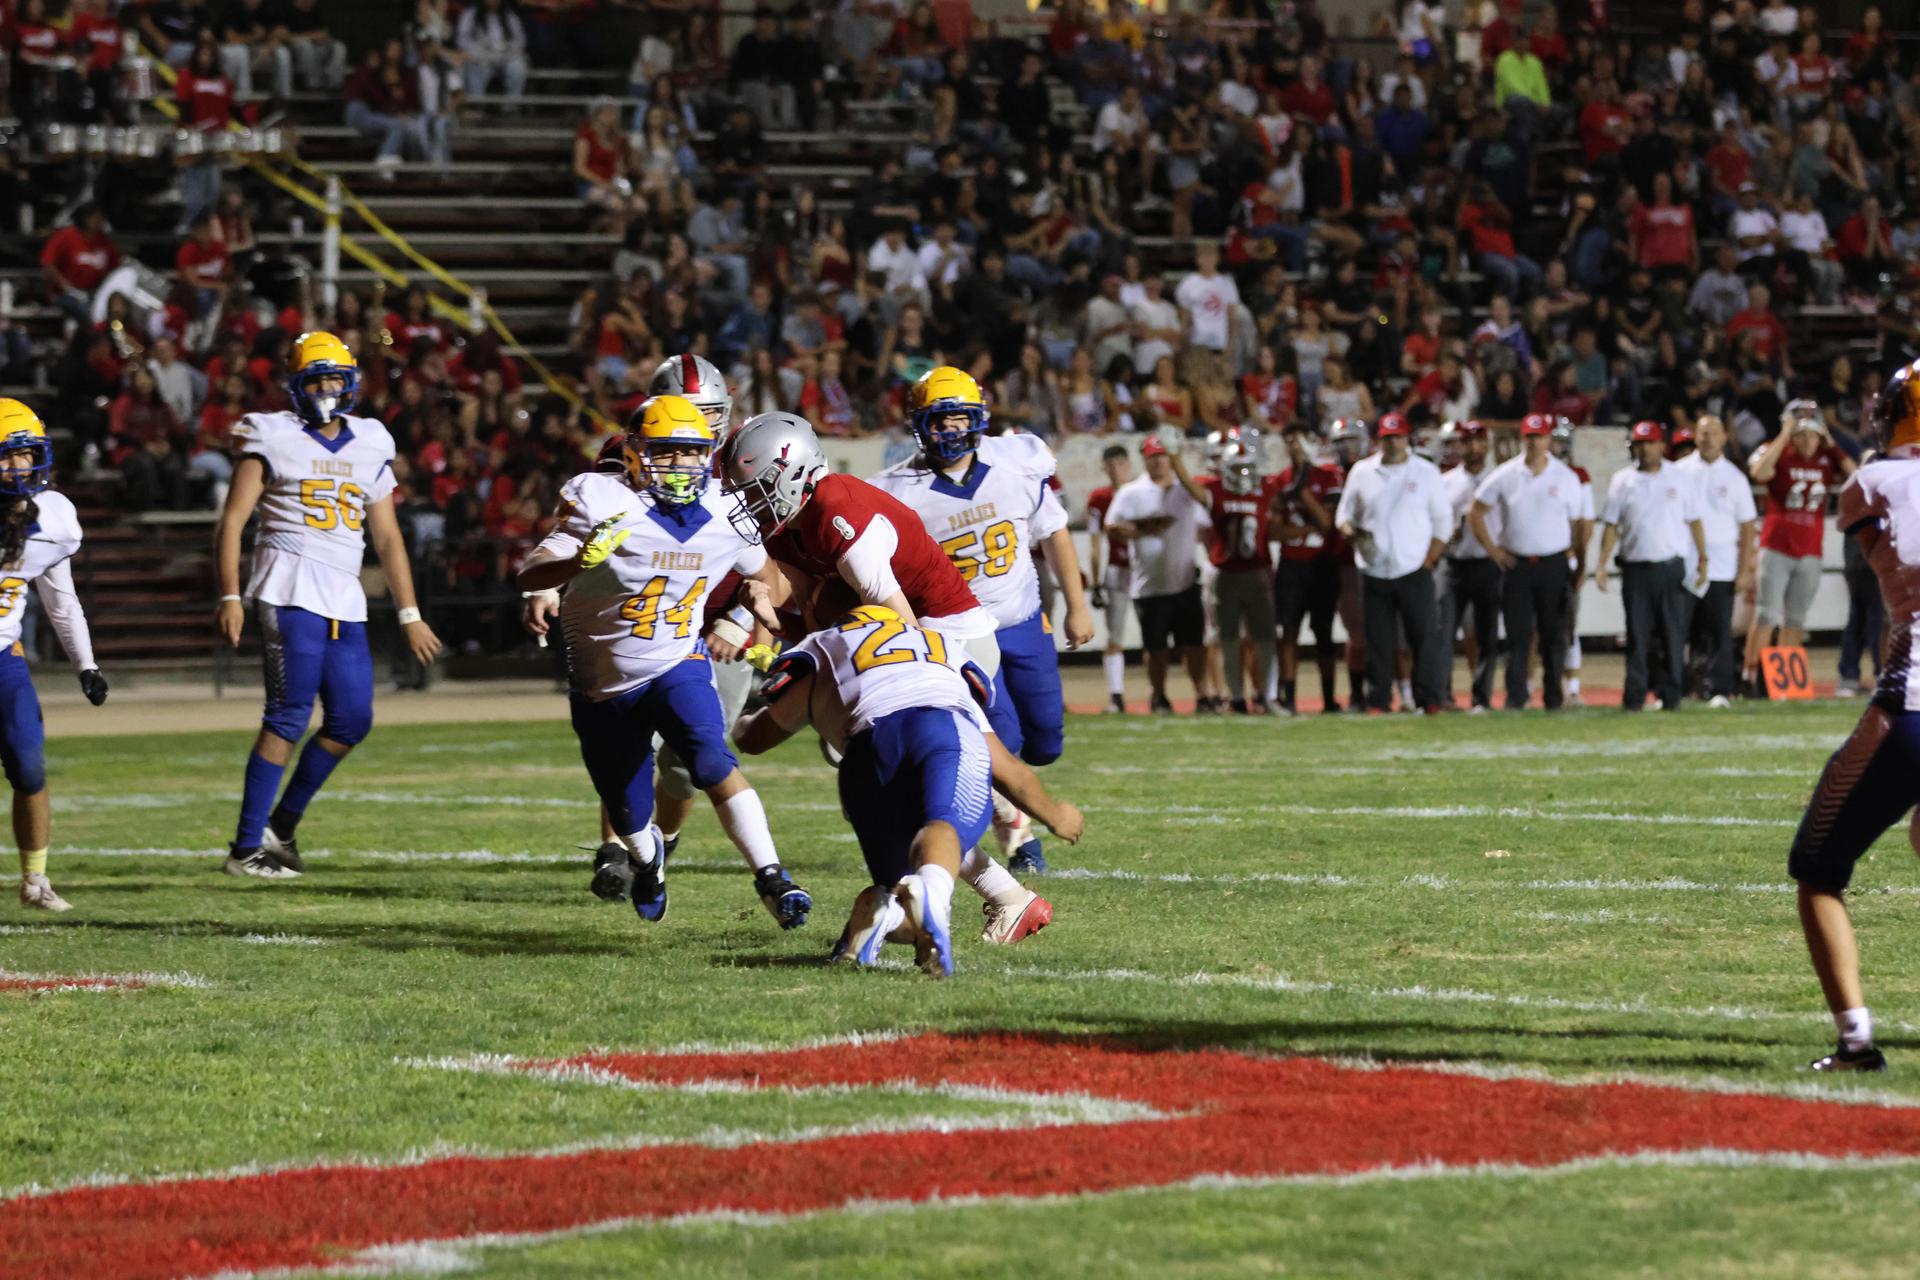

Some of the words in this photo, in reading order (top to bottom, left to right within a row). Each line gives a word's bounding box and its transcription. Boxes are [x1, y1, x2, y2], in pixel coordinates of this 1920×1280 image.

[311, 459, 353, 479] PARLIER
[299, 478, 363, 532] 56
[948, 502, 997, 532] PARLIER
[832, 515, 856, 541] 8
[651, 551, 704, 571] PARLIER
[939, 519, 1019, 581] 58
[620, 574, 709, 640] 44
[838, 620, 957, 677] 21
[1768, 652, 1808, 690] 30
